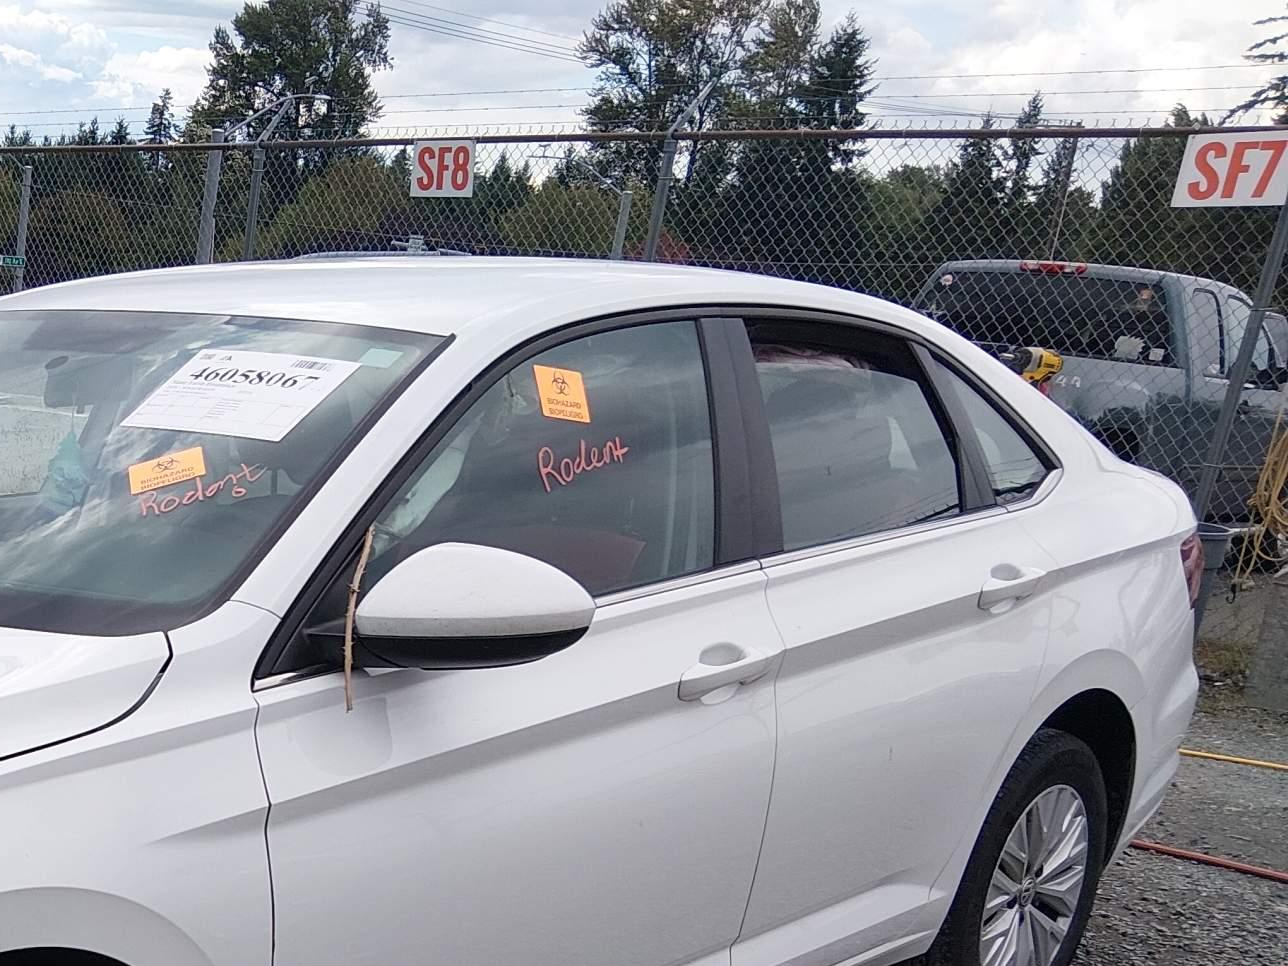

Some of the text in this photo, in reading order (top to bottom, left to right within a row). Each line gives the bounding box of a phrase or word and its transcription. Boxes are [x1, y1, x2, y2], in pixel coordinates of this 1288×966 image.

[416, 145, 470, 192] SF8
[1187, 139, 1288, 201] SF7
[190, 366, 321, 391] 46058067
[546, 397, 582, 410] BIOHAZARD
[140, 466, 195, 486] BIOHAZARD
[538, 436, 630, 493] Rodent
